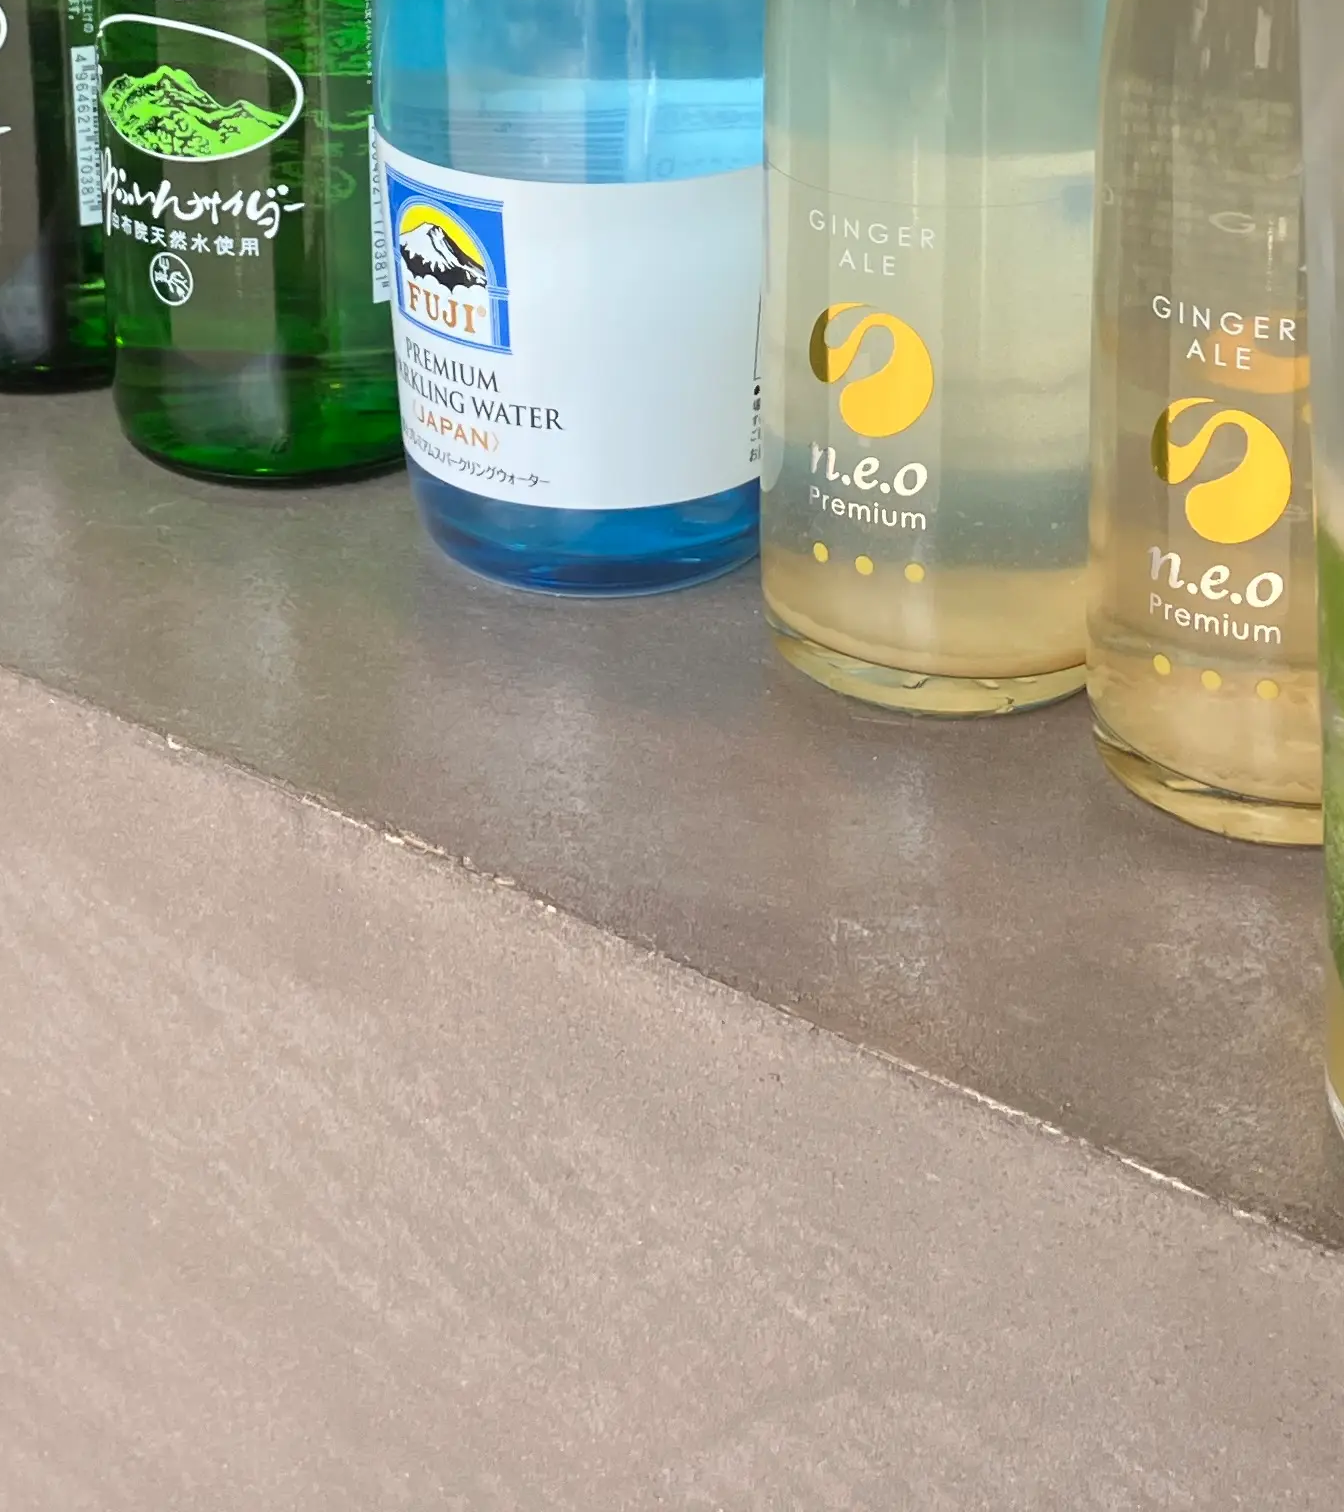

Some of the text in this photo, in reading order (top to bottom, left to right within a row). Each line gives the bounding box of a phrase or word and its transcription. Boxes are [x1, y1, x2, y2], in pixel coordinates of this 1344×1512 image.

[75, 73, 91, 135] 964621
[79, 147, 94, 206] 170381
[809, 208, 936, 250] GINGER
[838, 249, 897, 276] ALE
[407, 280, 476, 334] FUJI
[1152, 294, 1297, 342] GINGER
[406, 336, 500, 393] PREMIUM
[1186, 338, 1252, 370] ALE
[471, 395, 565, 431] WATER
[809, 440, 928, 497] n.e.o
[809, 484, 927, 532] Premium
[1148, 545, 1284, 608] n.e.o
[1149, 591, 1282, 645] Premium
